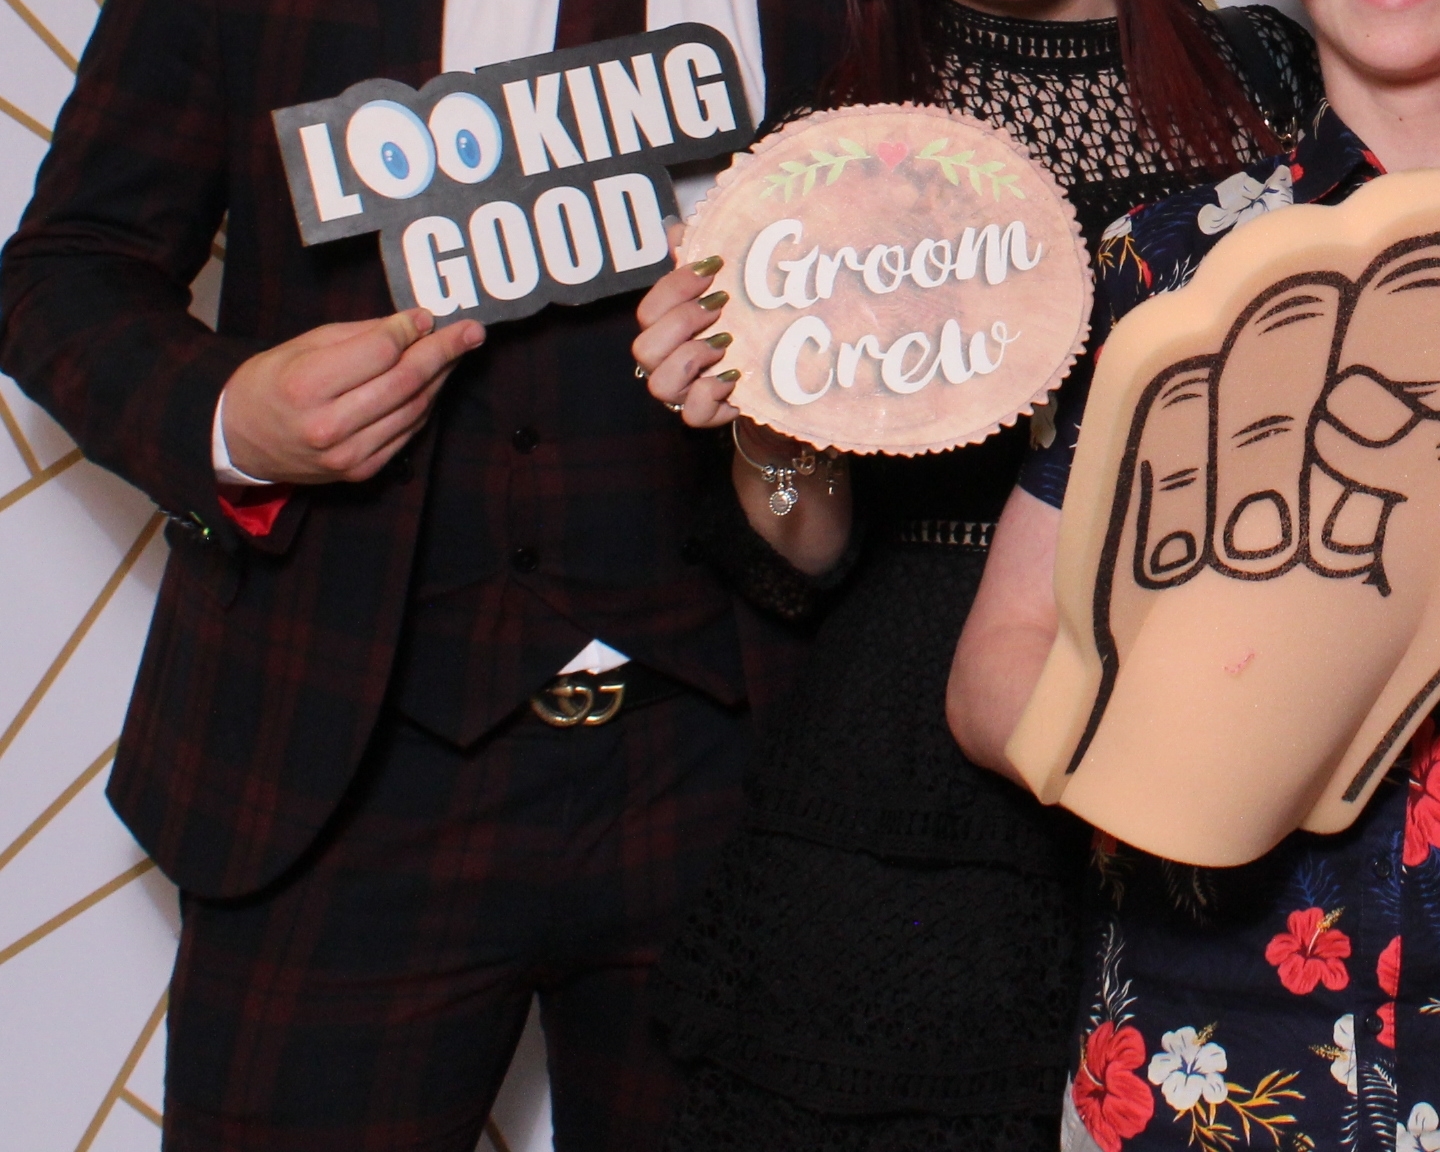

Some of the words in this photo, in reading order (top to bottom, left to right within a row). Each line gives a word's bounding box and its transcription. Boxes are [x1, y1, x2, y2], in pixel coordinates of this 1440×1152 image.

[300, 42, 736, 223] LOOKING
[402, 172, 669, 317] GOOD
[744, 218, 1042, 310] Groom
[770, 314, 1021, 406] Crew
